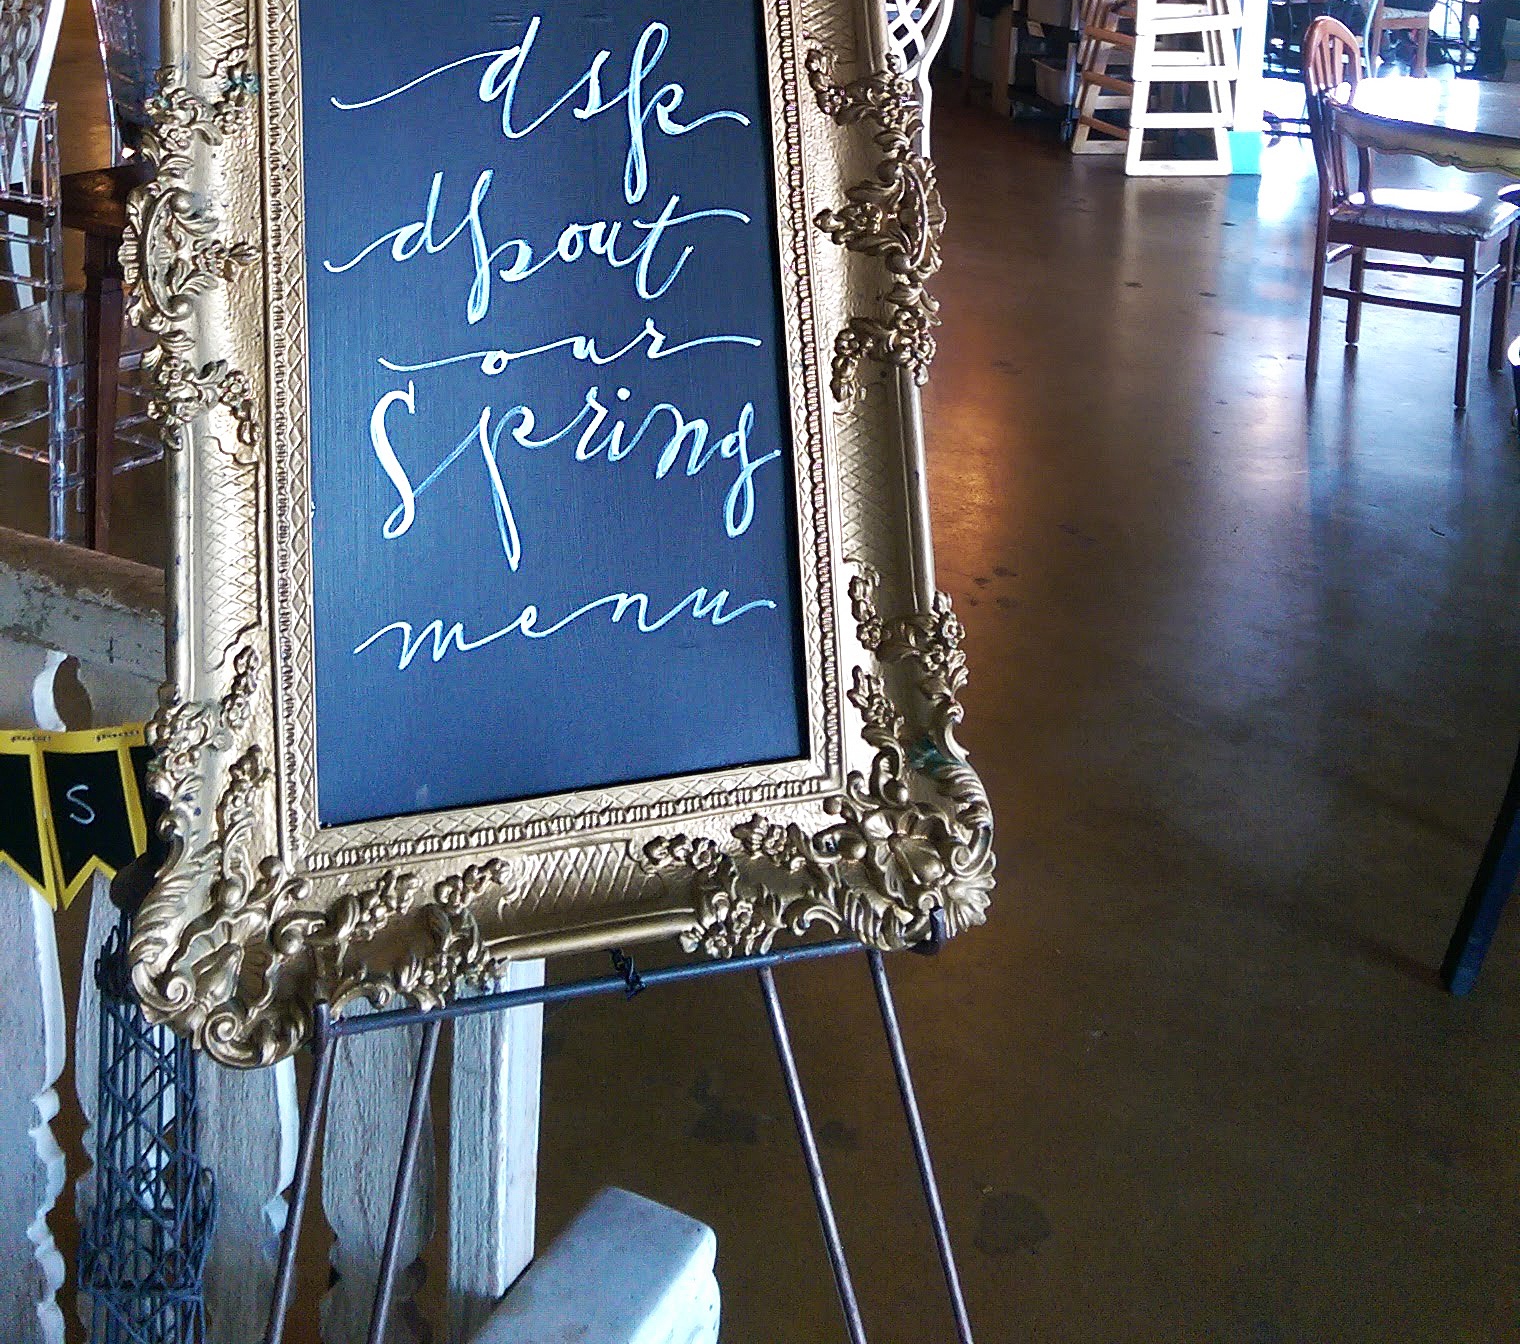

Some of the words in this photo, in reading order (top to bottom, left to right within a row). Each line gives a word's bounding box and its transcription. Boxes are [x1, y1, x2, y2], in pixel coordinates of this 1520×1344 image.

[331, 16, 752, 205] ask
[324, 169, 752, 325] about
[377, 317, 762, 376] our
[370, 380, 782, 573] Spring
[353, 585, 777, 671] menu
[66, 783, 96, 825] S
